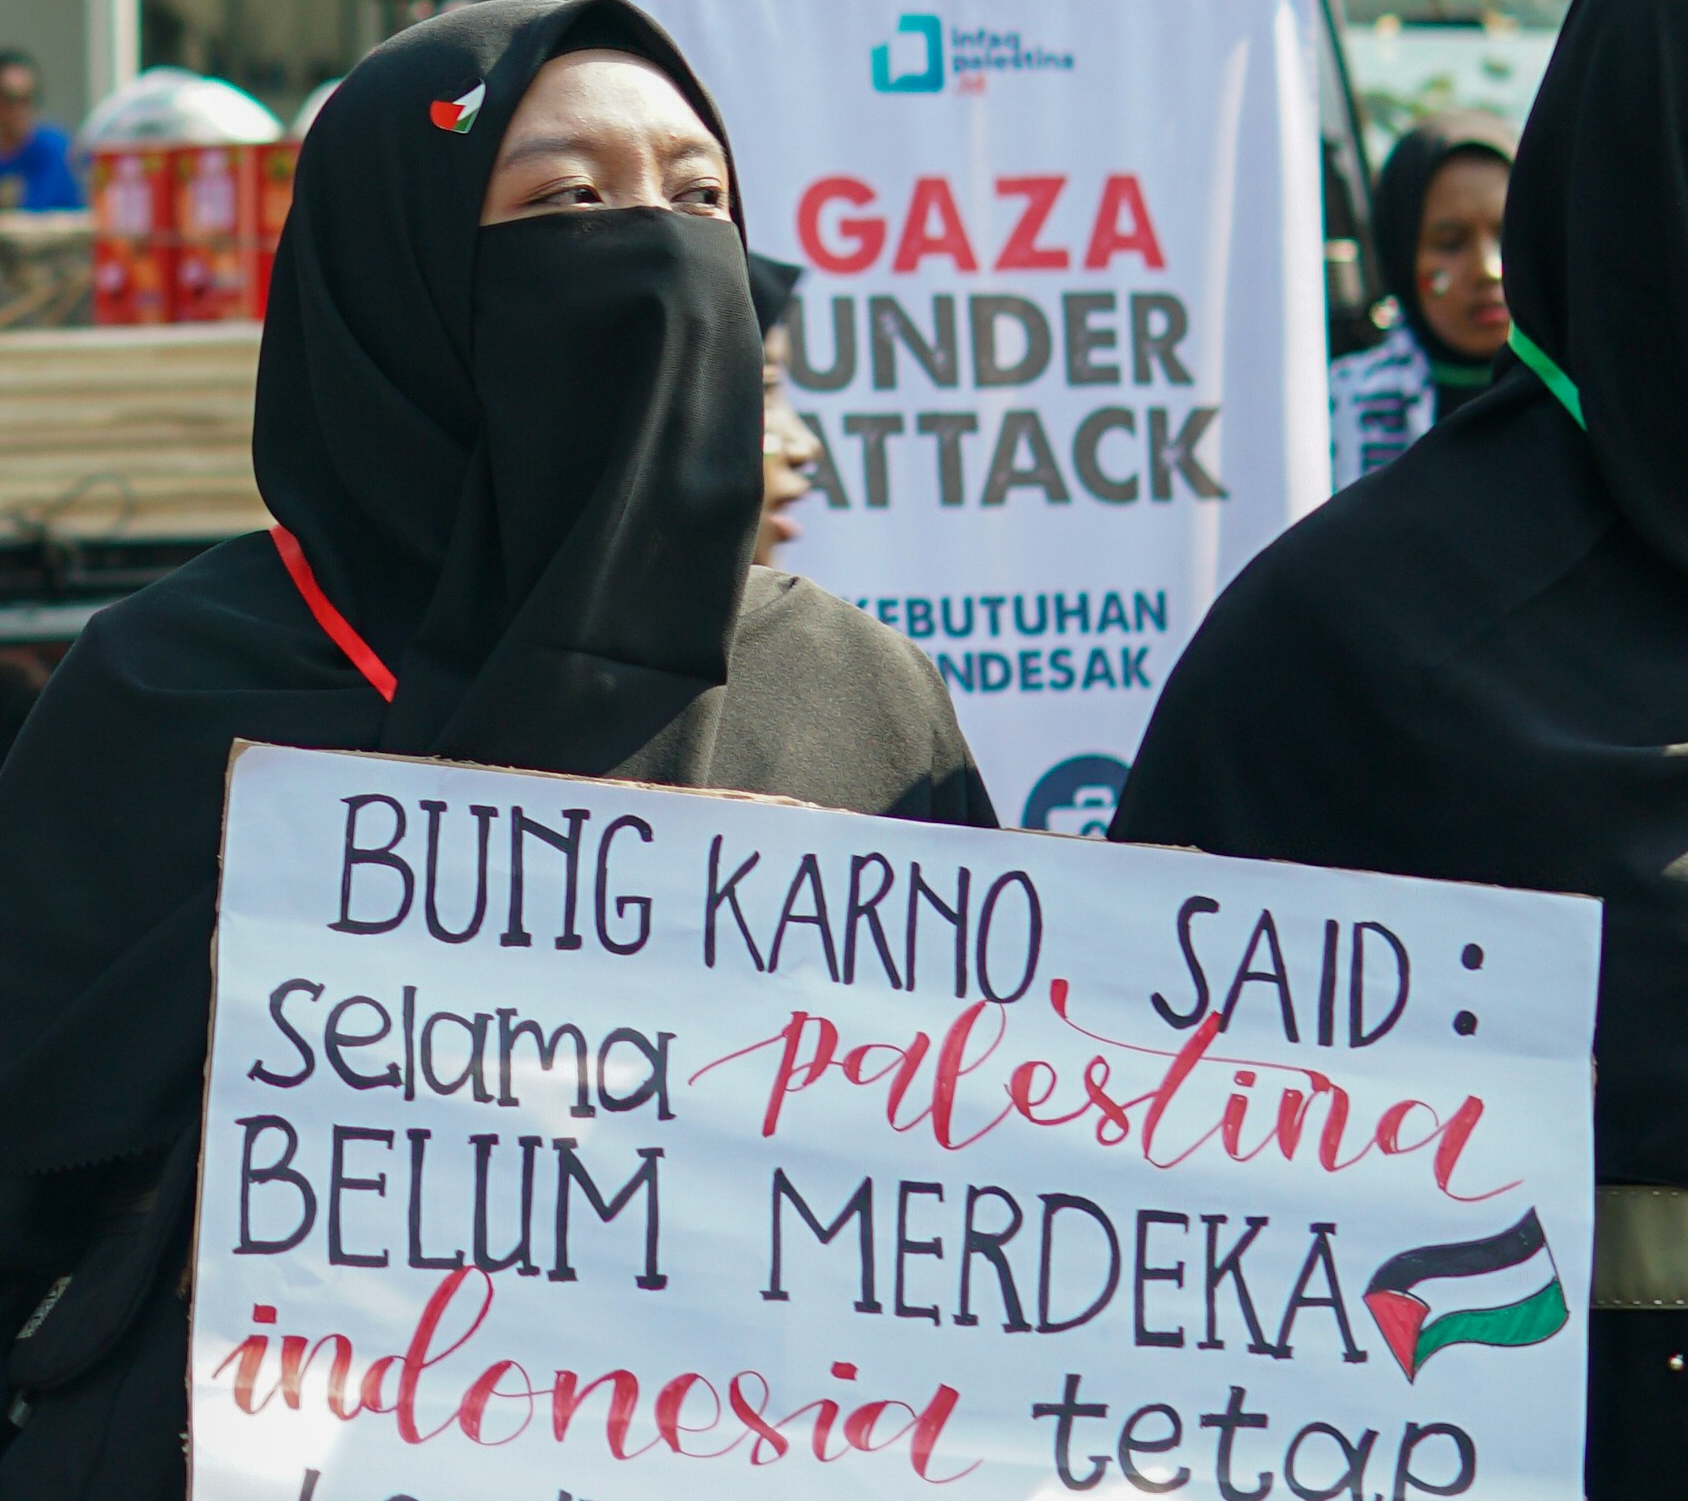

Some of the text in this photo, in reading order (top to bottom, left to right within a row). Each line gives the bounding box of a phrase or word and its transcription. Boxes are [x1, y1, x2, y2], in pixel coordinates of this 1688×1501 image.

[796, 171, 1166, 275] GAZA
[787, 291, 1195, 393] UNDER
[799, 406, 1229, 508] ATTACK
[328, 794, 653, 956] BUNG
[703, 834, 1043, 1003] KARNO
[248, 978, 1526, 1202] Selama palestina
[233, 1115, 1368, 1362] BELUM MERDEKA
[212, 1265, 983, 1485] indonesia
